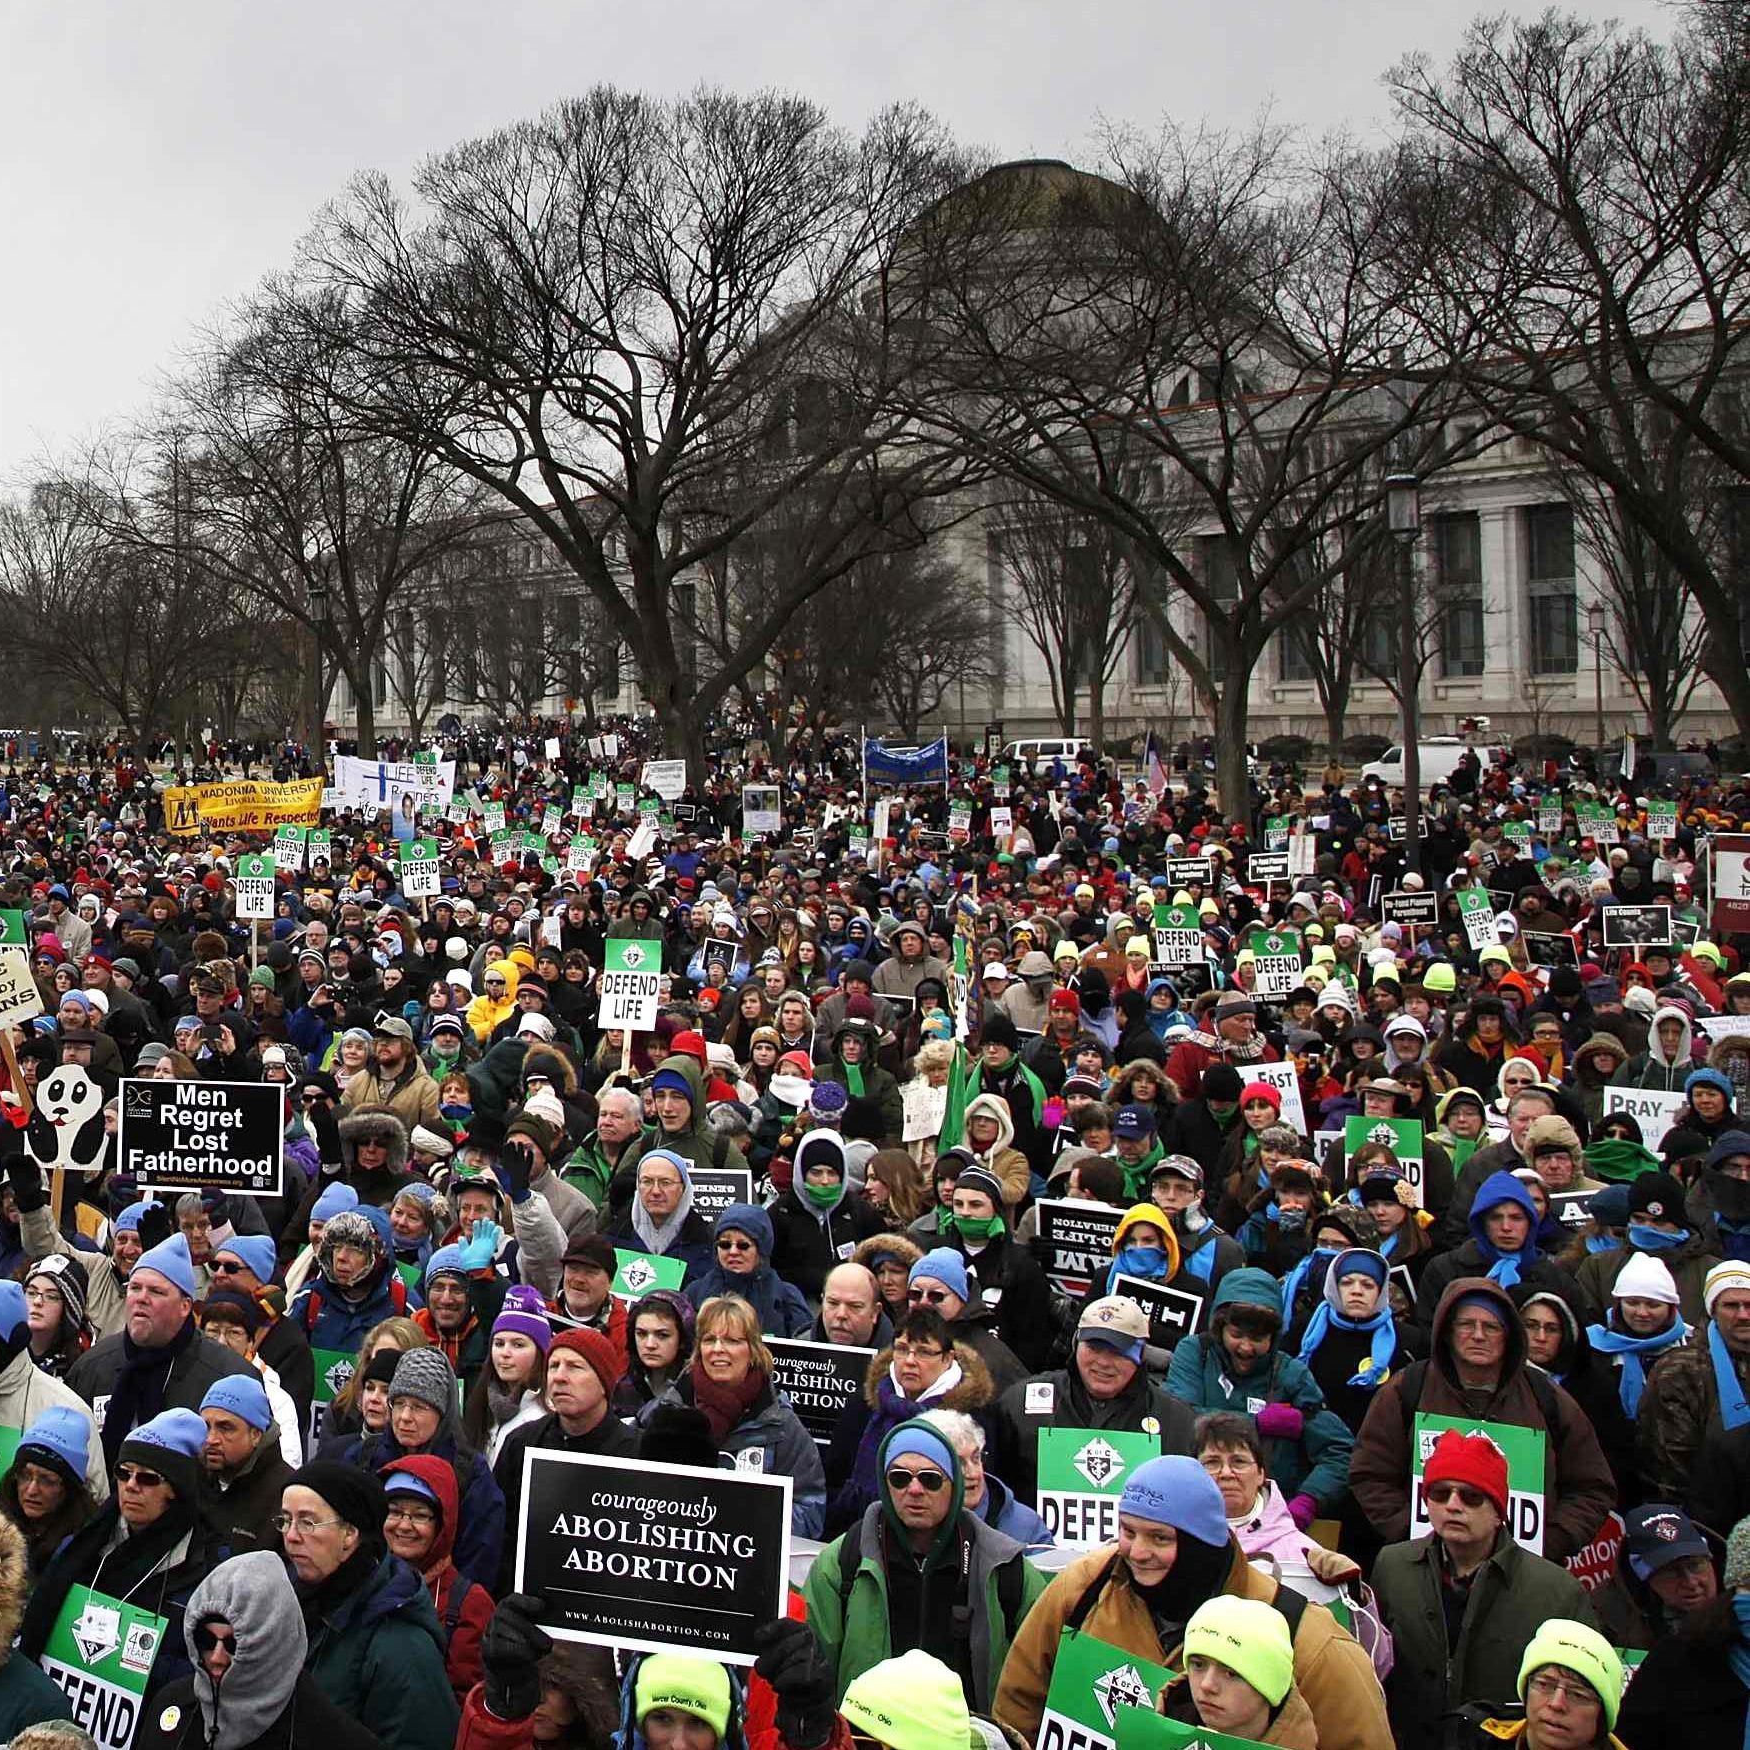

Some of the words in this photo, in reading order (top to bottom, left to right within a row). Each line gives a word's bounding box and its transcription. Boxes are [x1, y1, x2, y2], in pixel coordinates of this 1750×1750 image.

[386, 765, 415, 782] LIFE
[416, 765, 437, 776] DEFEND
[422, 775, 434, 785] LIFE
[200, 784, 257, 800] MADONNA
[260, 781, 323, 796] UNIVERSIT
[202, 815, 236, 829] Wants
[239, 813, 260, 827] Life
[264, 809, 319, 825] Respected
[1648, 815, 1675, 825] DEFEND
[1653, 824, 1669, 834] LIFE
[276, 840, 304, 854] DEFEND
[309, 844, 330, 854] DEFEND
[280, 853, 295, 865] LIFE
[403, 860, 438, 877] DEFEND
[238, 880, 274, 895] DEFEND
[412, 876, 432, 891] LIFE
[246, 896, 265, 912] LIFE
[1463, 910, 1493, 928] DEFEND
[1158, 930, 1200, 946] DEFEND
[1471, 926, 1492, 942] LIFE
[1168, 948, 1192, 963] LIFE
[1256, 957, 1300, 973] DEFEND
[604, 974, 658, 996] DEFEND
[1267, 975, 1292, 992] LIFE
[613, 998, 643, 1020] LIFE
[1257, 1070, 1292, 1088] FAST
[176, 1084, 227, 1107] Men
[1609, 1093, 1663, 1118] PRAY
[160, 1104, 243, 1132] Regret
[174, 1128, 229, 1152] Lost
[128, 1149, 272, 1176] Fatherhood
[1052, 1217, 1118, 1233] NERATION
[1052, 1229, 1114, 1246] O-LIFE
[772, 1357, 837, 1377] ourageously
[772, 1371, 858, 1395] OLISHING
[790, 1390, 848, 1410] RTION
[591, 1492, 717, 1527] courageously
[1042, 1497, 1115, 1543] DEFE
[549, 1513, 757, 1559] ABOLISHING
[561, 1547, 739, 1592] ABORTION
[47, 1666, 136, 1749] FEND
[877, 1713, 892, 1727] Ohio
